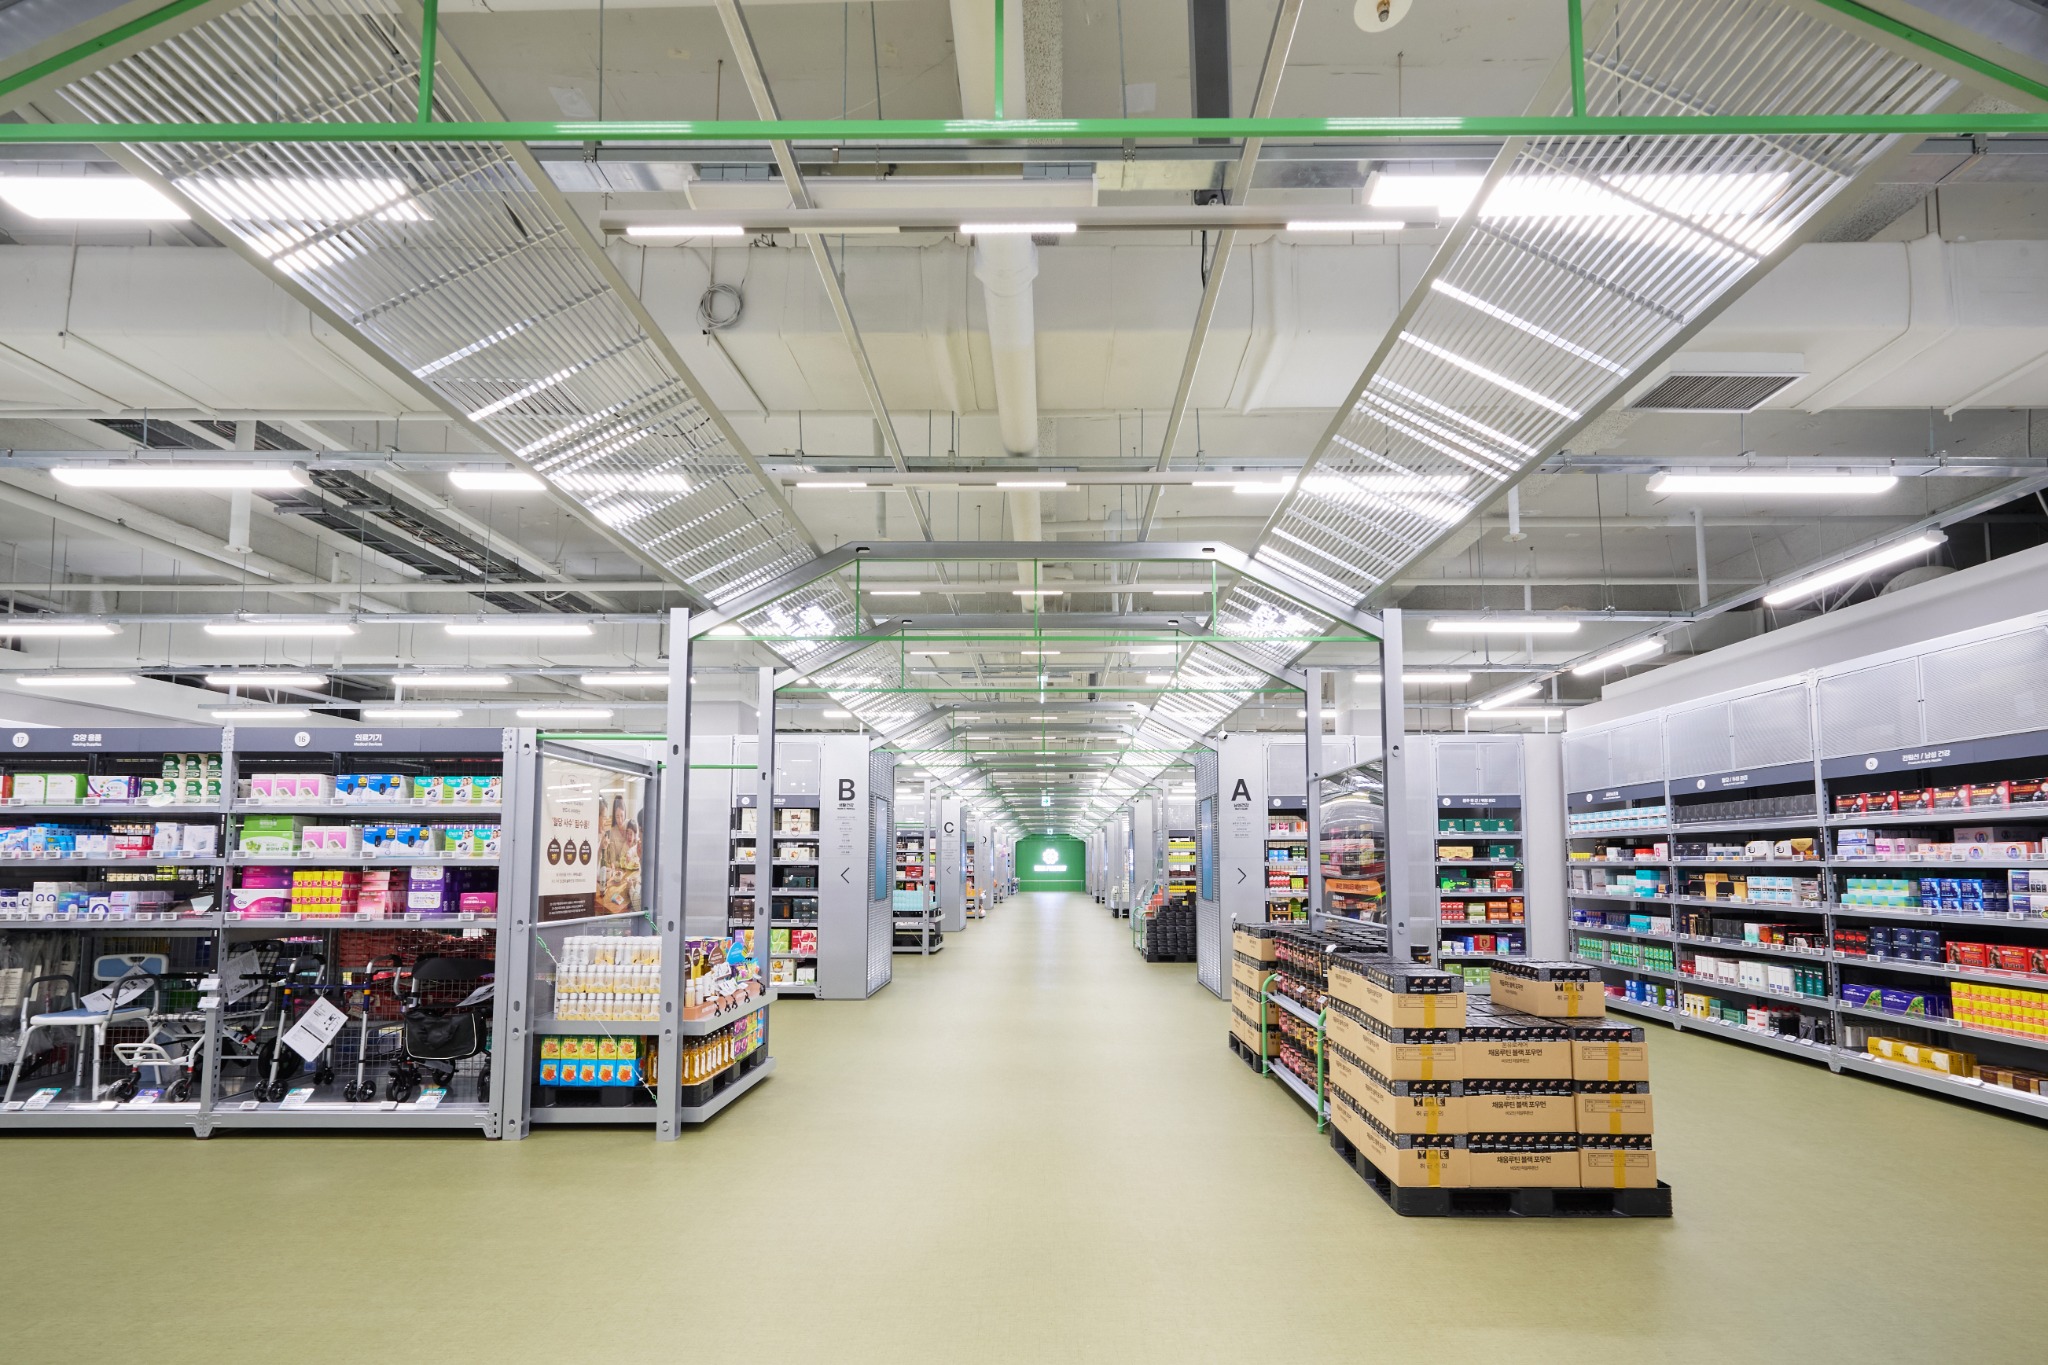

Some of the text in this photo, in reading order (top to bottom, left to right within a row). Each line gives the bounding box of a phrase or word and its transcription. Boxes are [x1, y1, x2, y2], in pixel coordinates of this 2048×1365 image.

[354, 733, 382, 742] 의료기기
[838, 778, 856, 801] B
[1231, 778, 1252, 801] A
[943, 821, 954, 834] C
[1516, 1101, 1529, 1109] 블랙
[1521, 1156, 1533, 1164] 블랙
